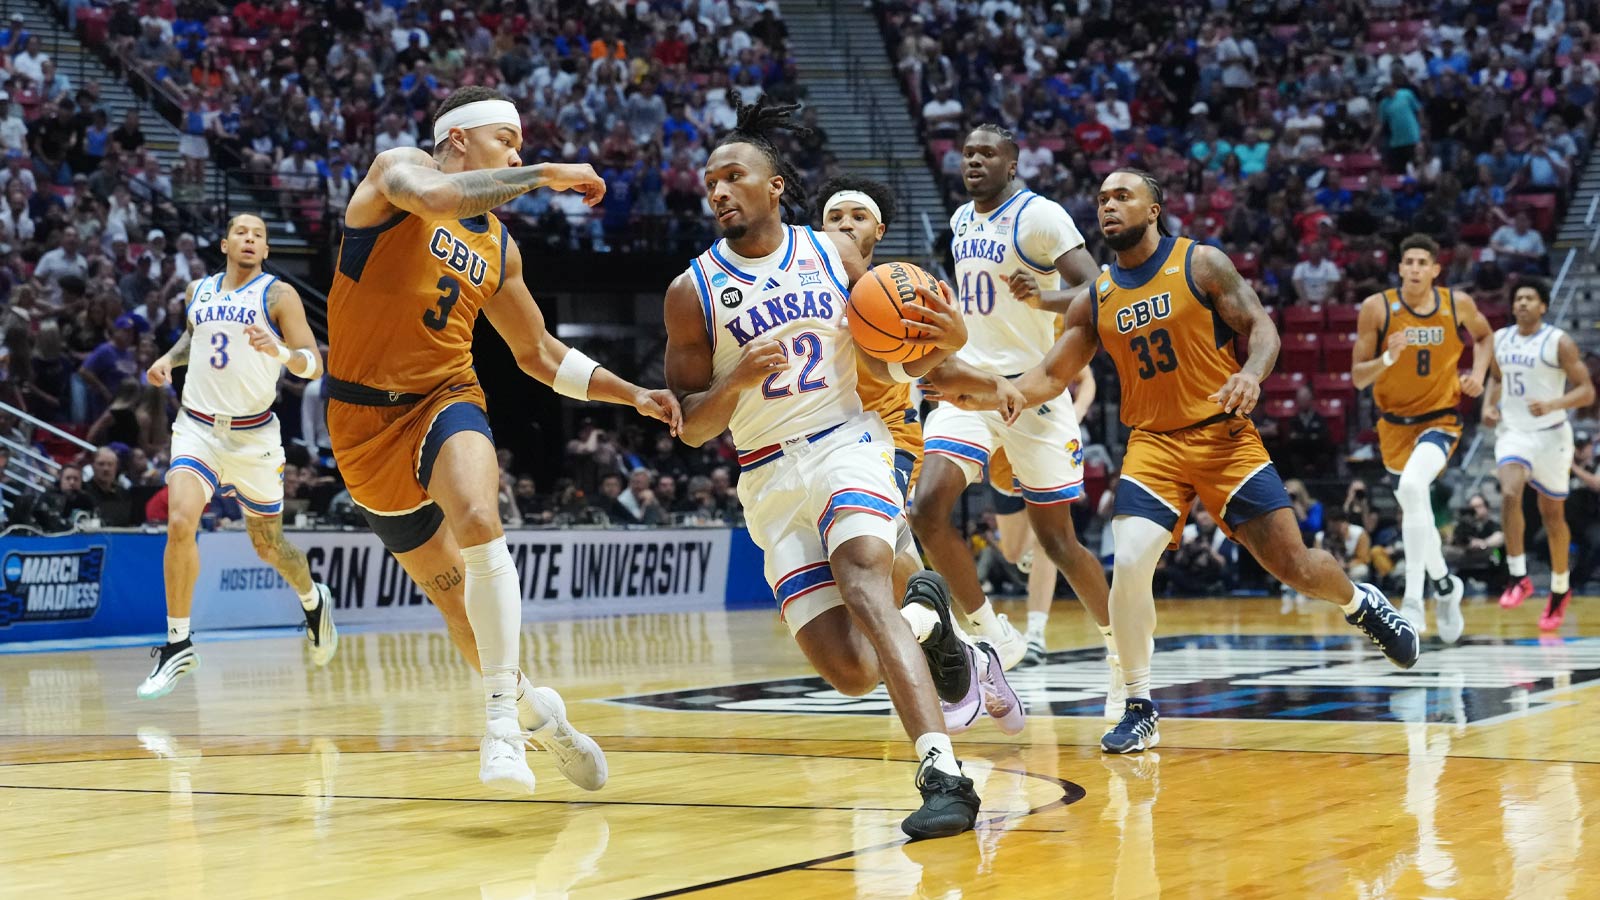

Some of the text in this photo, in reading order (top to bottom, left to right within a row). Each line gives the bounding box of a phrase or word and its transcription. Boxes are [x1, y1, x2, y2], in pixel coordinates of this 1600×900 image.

[429, 226, 488, 288] CBU
[954, 238, 1006, 264] KANSAS
[723, 290, 741, 305] SW
[889, 262, 917, 305] Wilso
[961, 270, 996, 316] 40
[195, 305, 257, 326] KANSAS
[423, 275, 461, 332] 3
[724, 290, 834, 348] KANSAS
[1116, 291, 1172, 334] CBU
[209, 331, 230, 370] 3
[1404, 326, 1444, 346] CBU
[1130, 328, 1178, 380] 33
[1416, 348, 1431, 377] 8
[1506, 371, 1525, 398] 15
[21, 556, 80, 584] MARCH
[220, 567, 275, 592] HOSTED
[306, 546, 370, 609] SAN
[570, 541, 713, 599] UNIVERSITY
[27, 583, 100, 612] MADNESS
